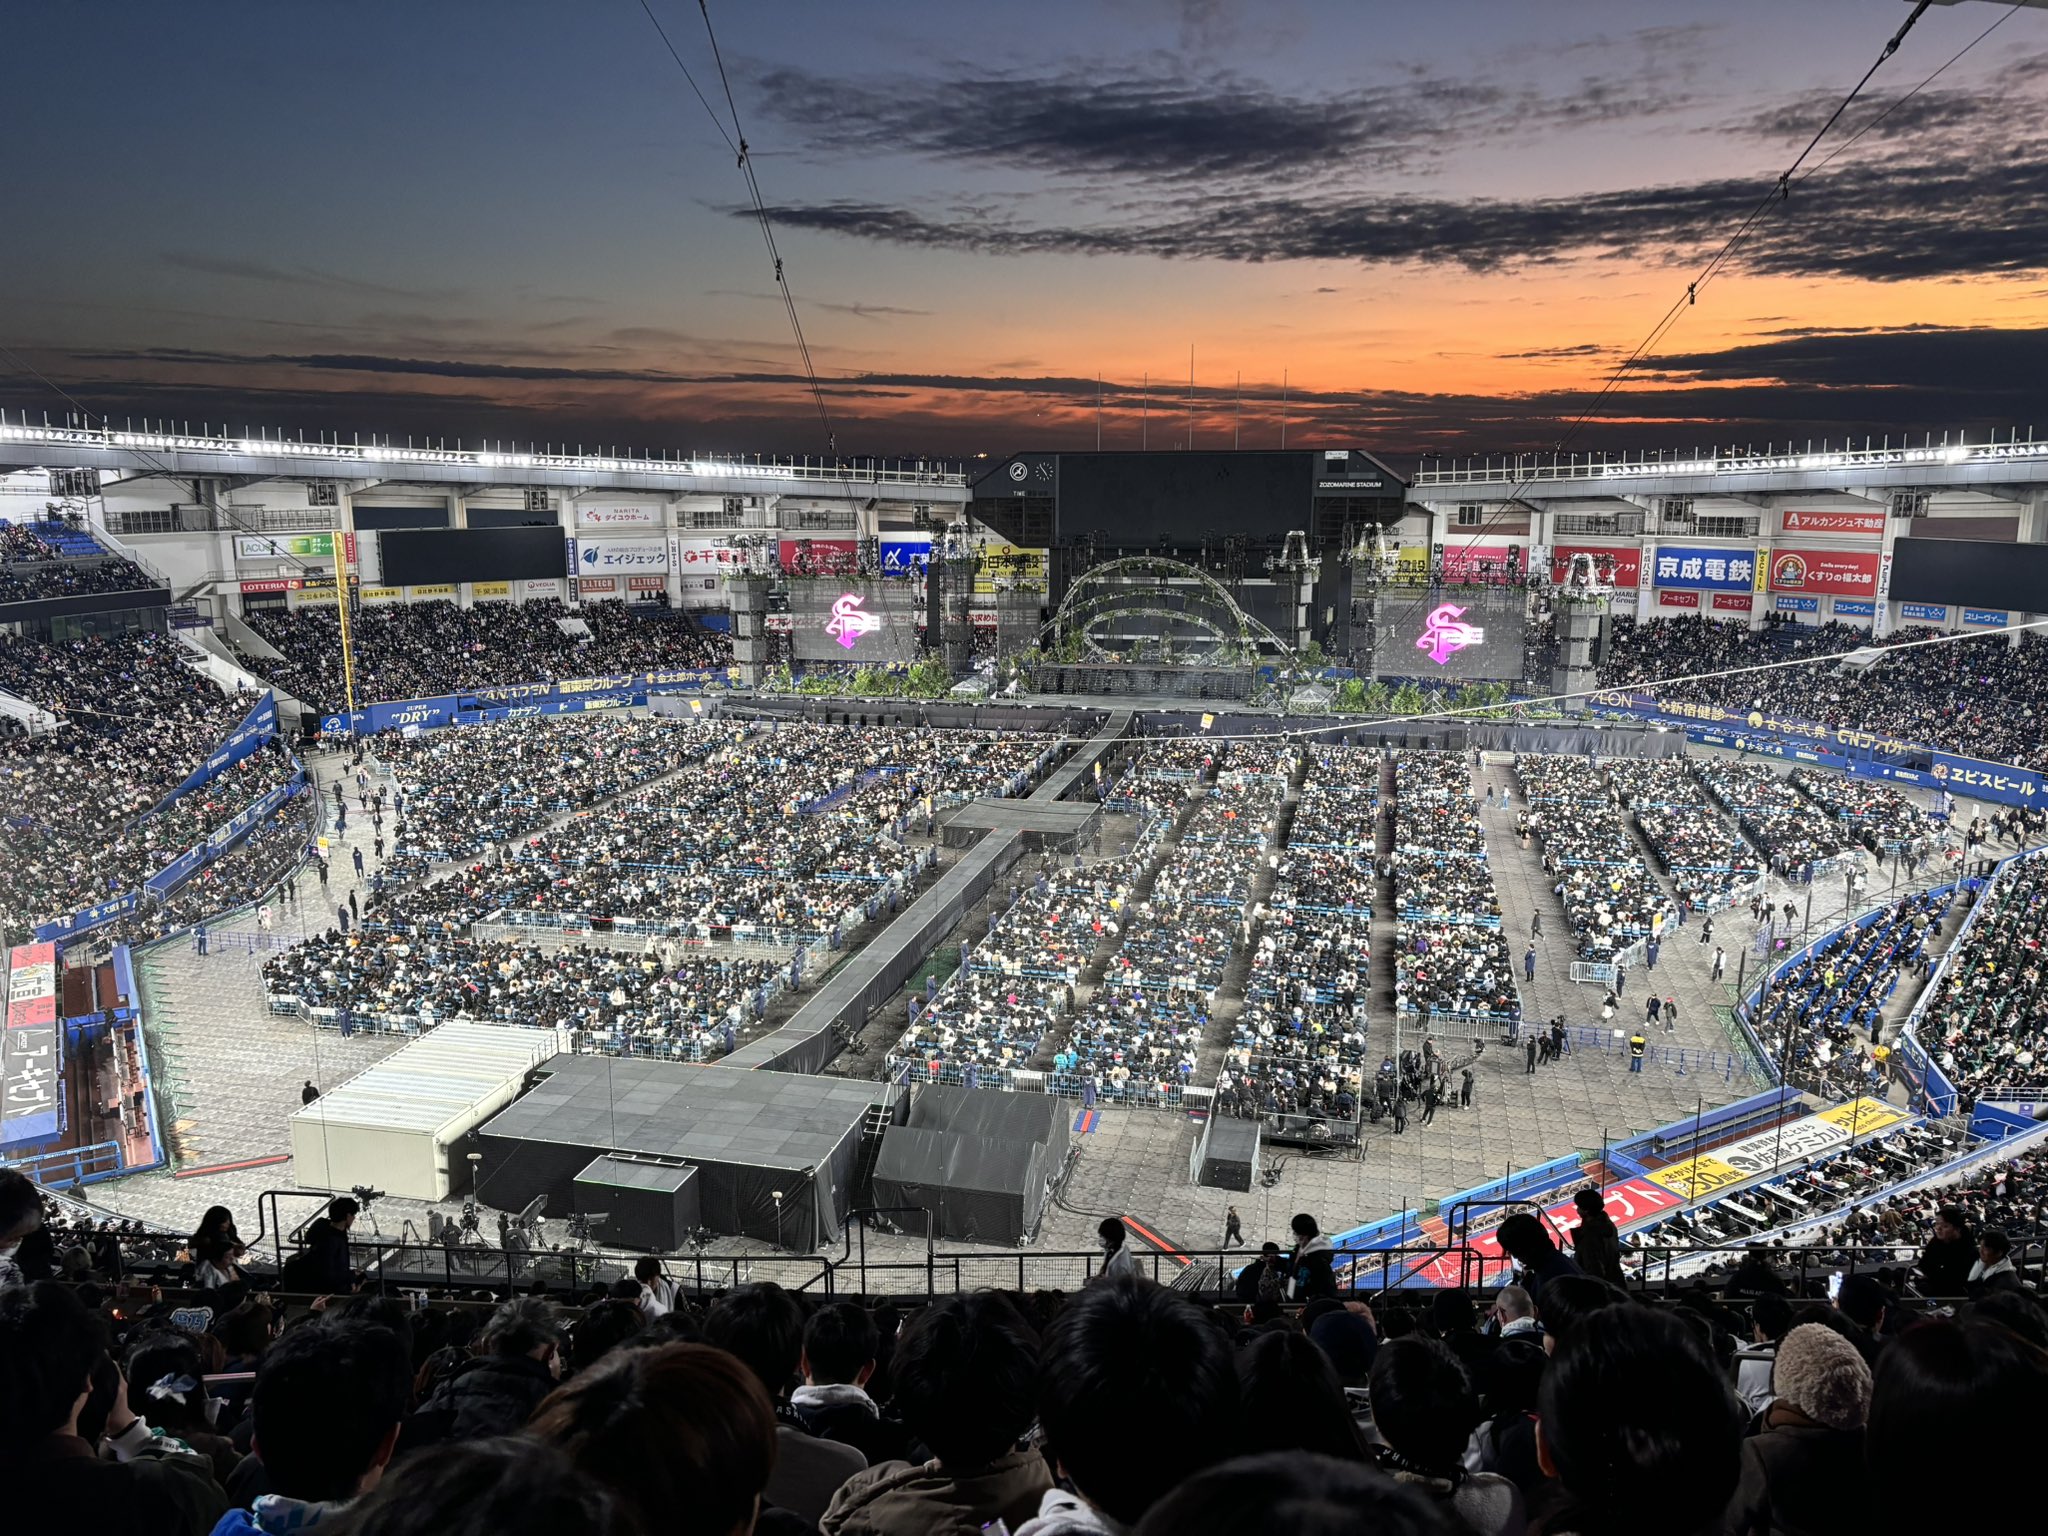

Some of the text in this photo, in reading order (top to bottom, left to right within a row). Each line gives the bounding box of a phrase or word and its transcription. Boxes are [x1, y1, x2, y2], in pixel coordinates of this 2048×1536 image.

[1801, 516, 1884, 529] アルカンジュ不動産
[603, 553, 666, 565] エイジェック
[1657, 556, 1752, 582] 京成電鉄
[1807, 571, 1873, 584] くすりの福太郎
[243, 583, 286, 591] LOTTERIA
[1662, 593, 1697, 603] アーキセプト
[1715, 597, 1752, 606] アーキセプト
[559, 674, 632, 694] 新東京グループ
[406, 704, 427, 712] SUPER
[584, 697, 633, 709] 新東京グループ
[508, 705, 541, 718] カナデン
[1670, 700, 1726, 721] 新宿健診
[1765, 716, 1828, 740] 古谷式典
[1746, 742, 1784, 755] 古谷式典
